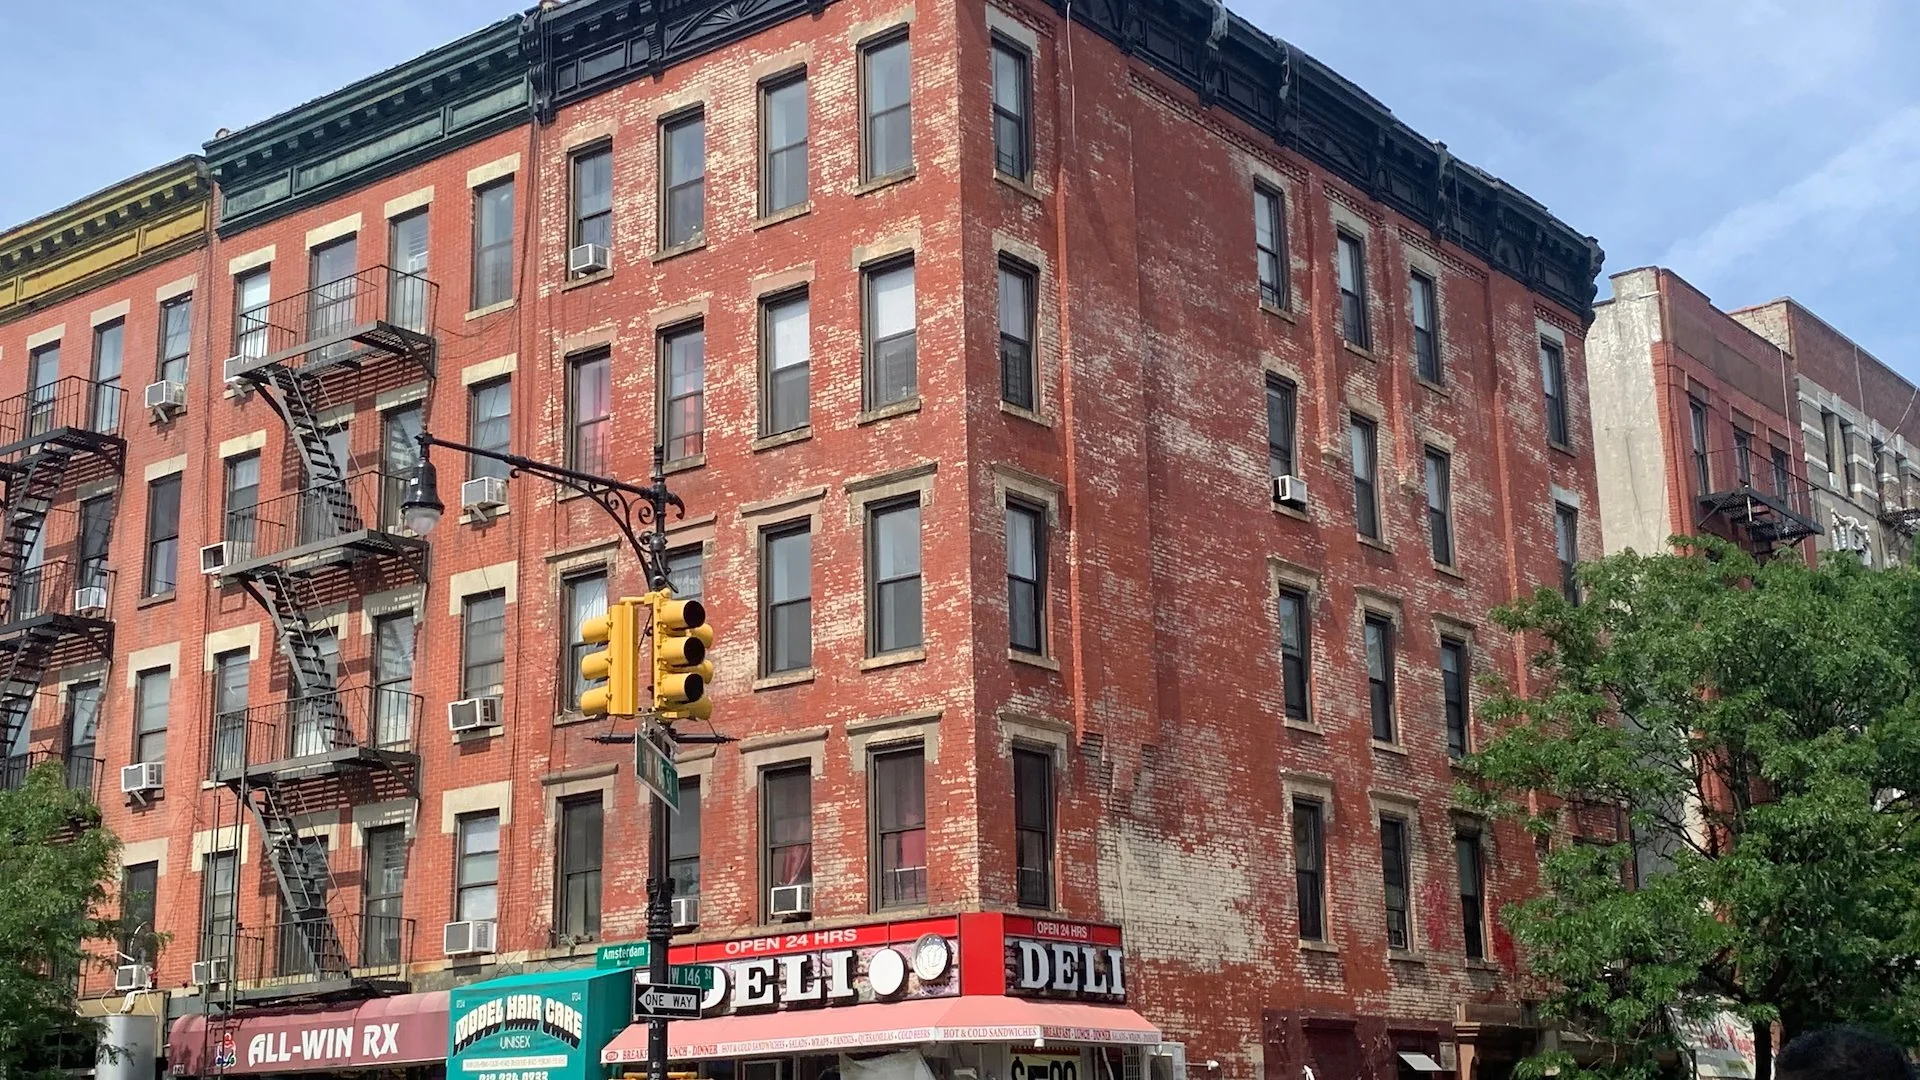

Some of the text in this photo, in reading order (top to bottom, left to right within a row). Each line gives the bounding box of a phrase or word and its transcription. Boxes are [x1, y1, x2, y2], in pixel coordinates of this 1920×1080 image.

[1037, 921, 1088, 938] OPEN 24 HRS
[725, 929, 857, 955] OPEN 24 HRS
[603, 945, 645, 961] Amsterdam
[671, 967, 712, 986] W 146 St
[1019, 941, 1126, 995] DELI
[645, 993, 693, 1008] ONE WAY
[454, 994, 583, 1048] MODEL HAIR CARE
[943, 1026, 1037, 1038] HOT & COLD SANDWICHES
[248, 1022, 400, 1067] ALL-WIN RX
[499, 1035, 531, 1050] UNISEX
[668, 1046, 688, 1057] UNCH
[692, 1044, 718, 1056] DINNER
